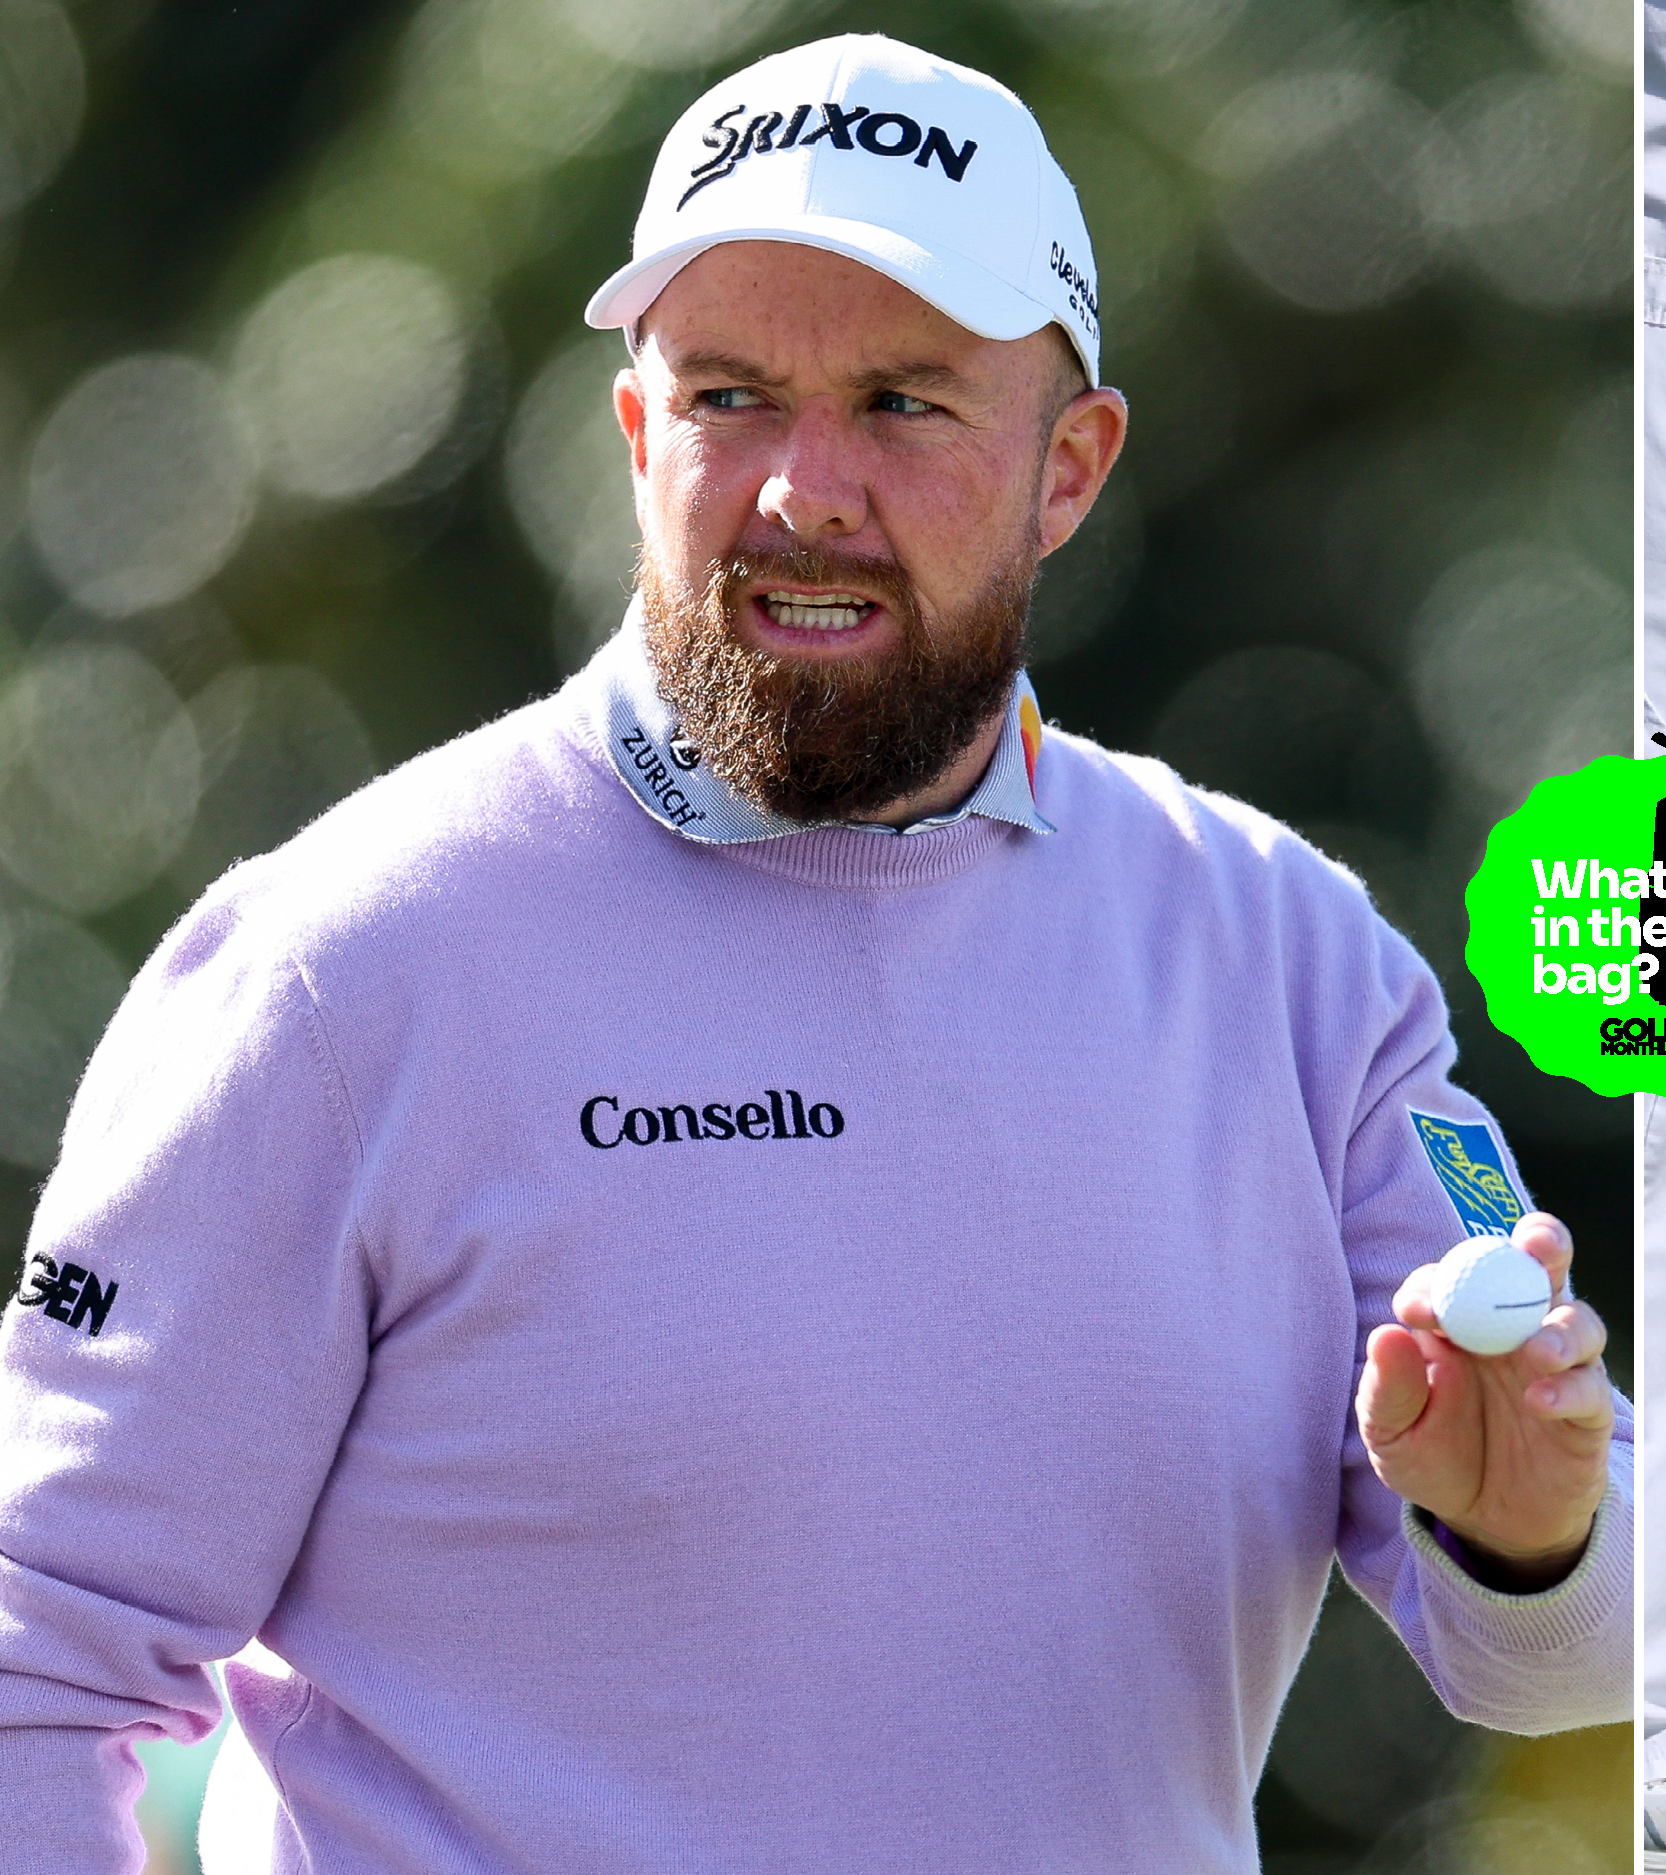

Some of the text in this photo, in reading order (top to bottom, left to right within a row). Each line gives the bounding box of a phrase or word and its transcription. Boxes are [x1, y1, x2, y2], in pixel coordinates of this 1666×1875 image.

[676, 103, 977, 212] SRIXON
[621, 727, 699, 827] ZURICH
[580, 1089, 845, 1149] Consello
